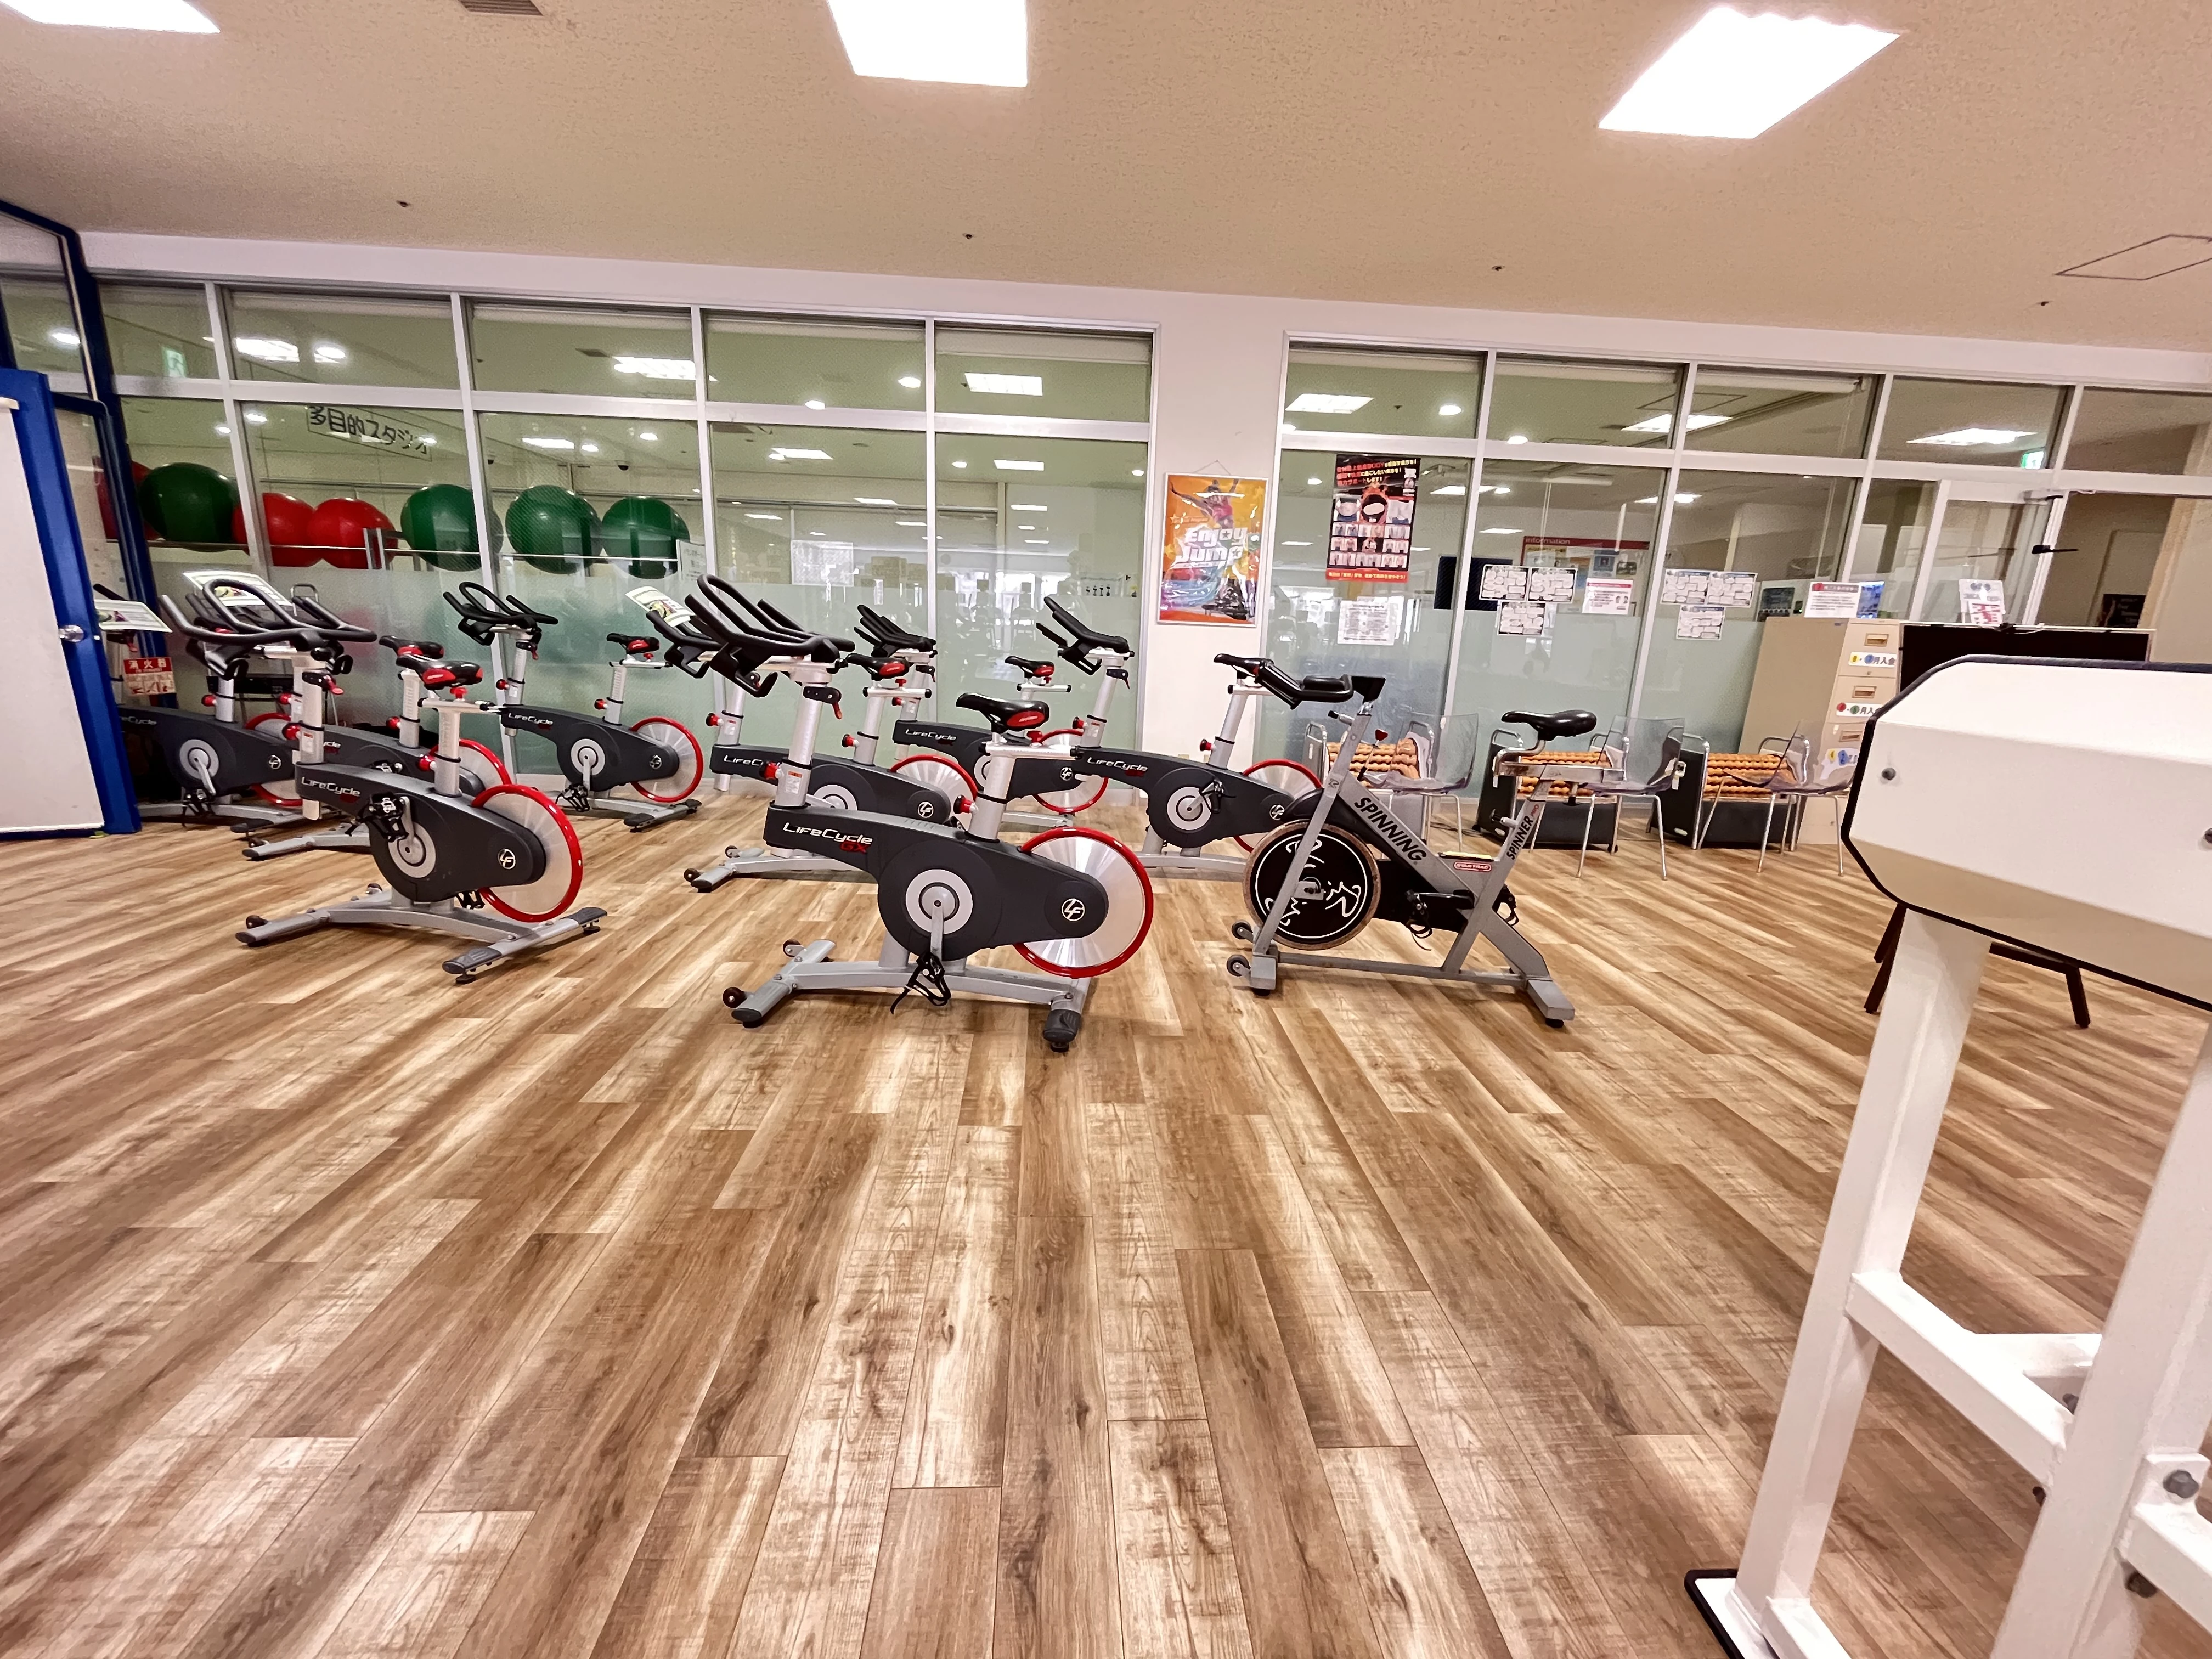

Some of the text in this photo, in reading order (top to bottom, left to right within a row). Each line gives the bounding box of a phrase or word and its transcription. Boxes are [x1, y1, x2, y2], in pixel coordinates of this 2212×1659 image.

[119, 716, 157, 725] eCycle
[509, 713, 553, 725] LifeCycle
[905, 729, 956, 741] LifeCycle
[723, 755, 780, 768] LifeC
[1087, 757, 1148, 771] LifeCycle
[301, 776, 360, 797] LifeCycle
[783, 822, 873, 845] LifeCycle
[1354, 797, 1427, 861] SPINNING
[1506, 804, 1539, 860] SPINNER PRO
[840, 842, 867, 854] GX
